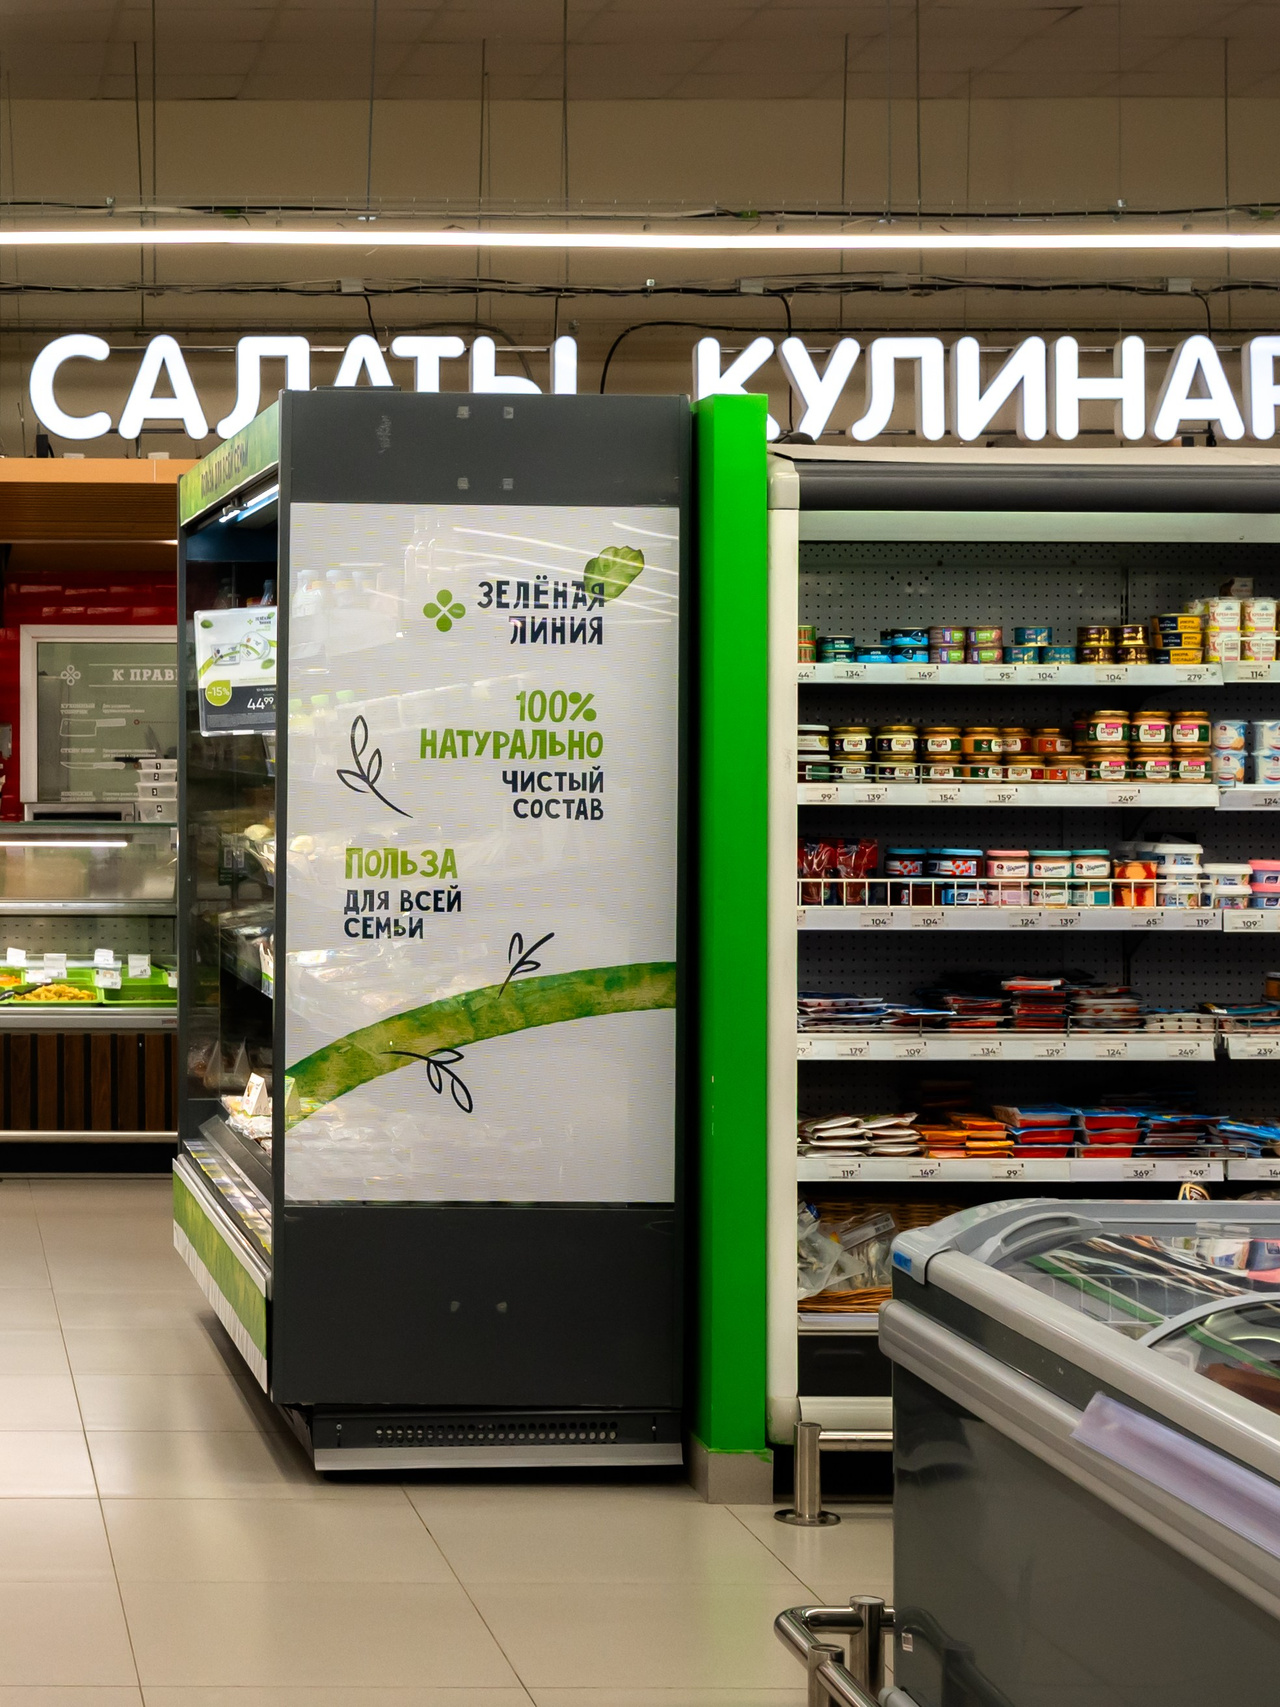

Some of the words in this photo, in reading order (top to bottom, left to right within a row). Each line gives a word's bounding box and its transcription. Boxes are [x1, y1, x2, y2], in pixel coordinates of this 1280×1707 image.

[477, 574, 605, 612] ЗЕЛЁНАЯ
[509, 615, 604, 645] ЛИНИЯ
[112, 669, 124, 681] К
[130, 669, 178, 681] ПРАВ
[208, 687, 230, 696] -15%
[247, 698, 265, 710] 44
[515, 689, 597, 723] 100%
[420, 728, 604, 760] НАТУРАЛЬНО
[502, 766, 604, 794] ЧИСТЫЙ
[513, 798, 604, 820] СОСТАВ
[344, 847, 458, 879] ПОЛЬЗА
[344, 889, 390, 915] ДЛЯ
[400, 885, 462, 912] ВСЕЙ
[344, 916, 424, 940] СЕМЬИ
